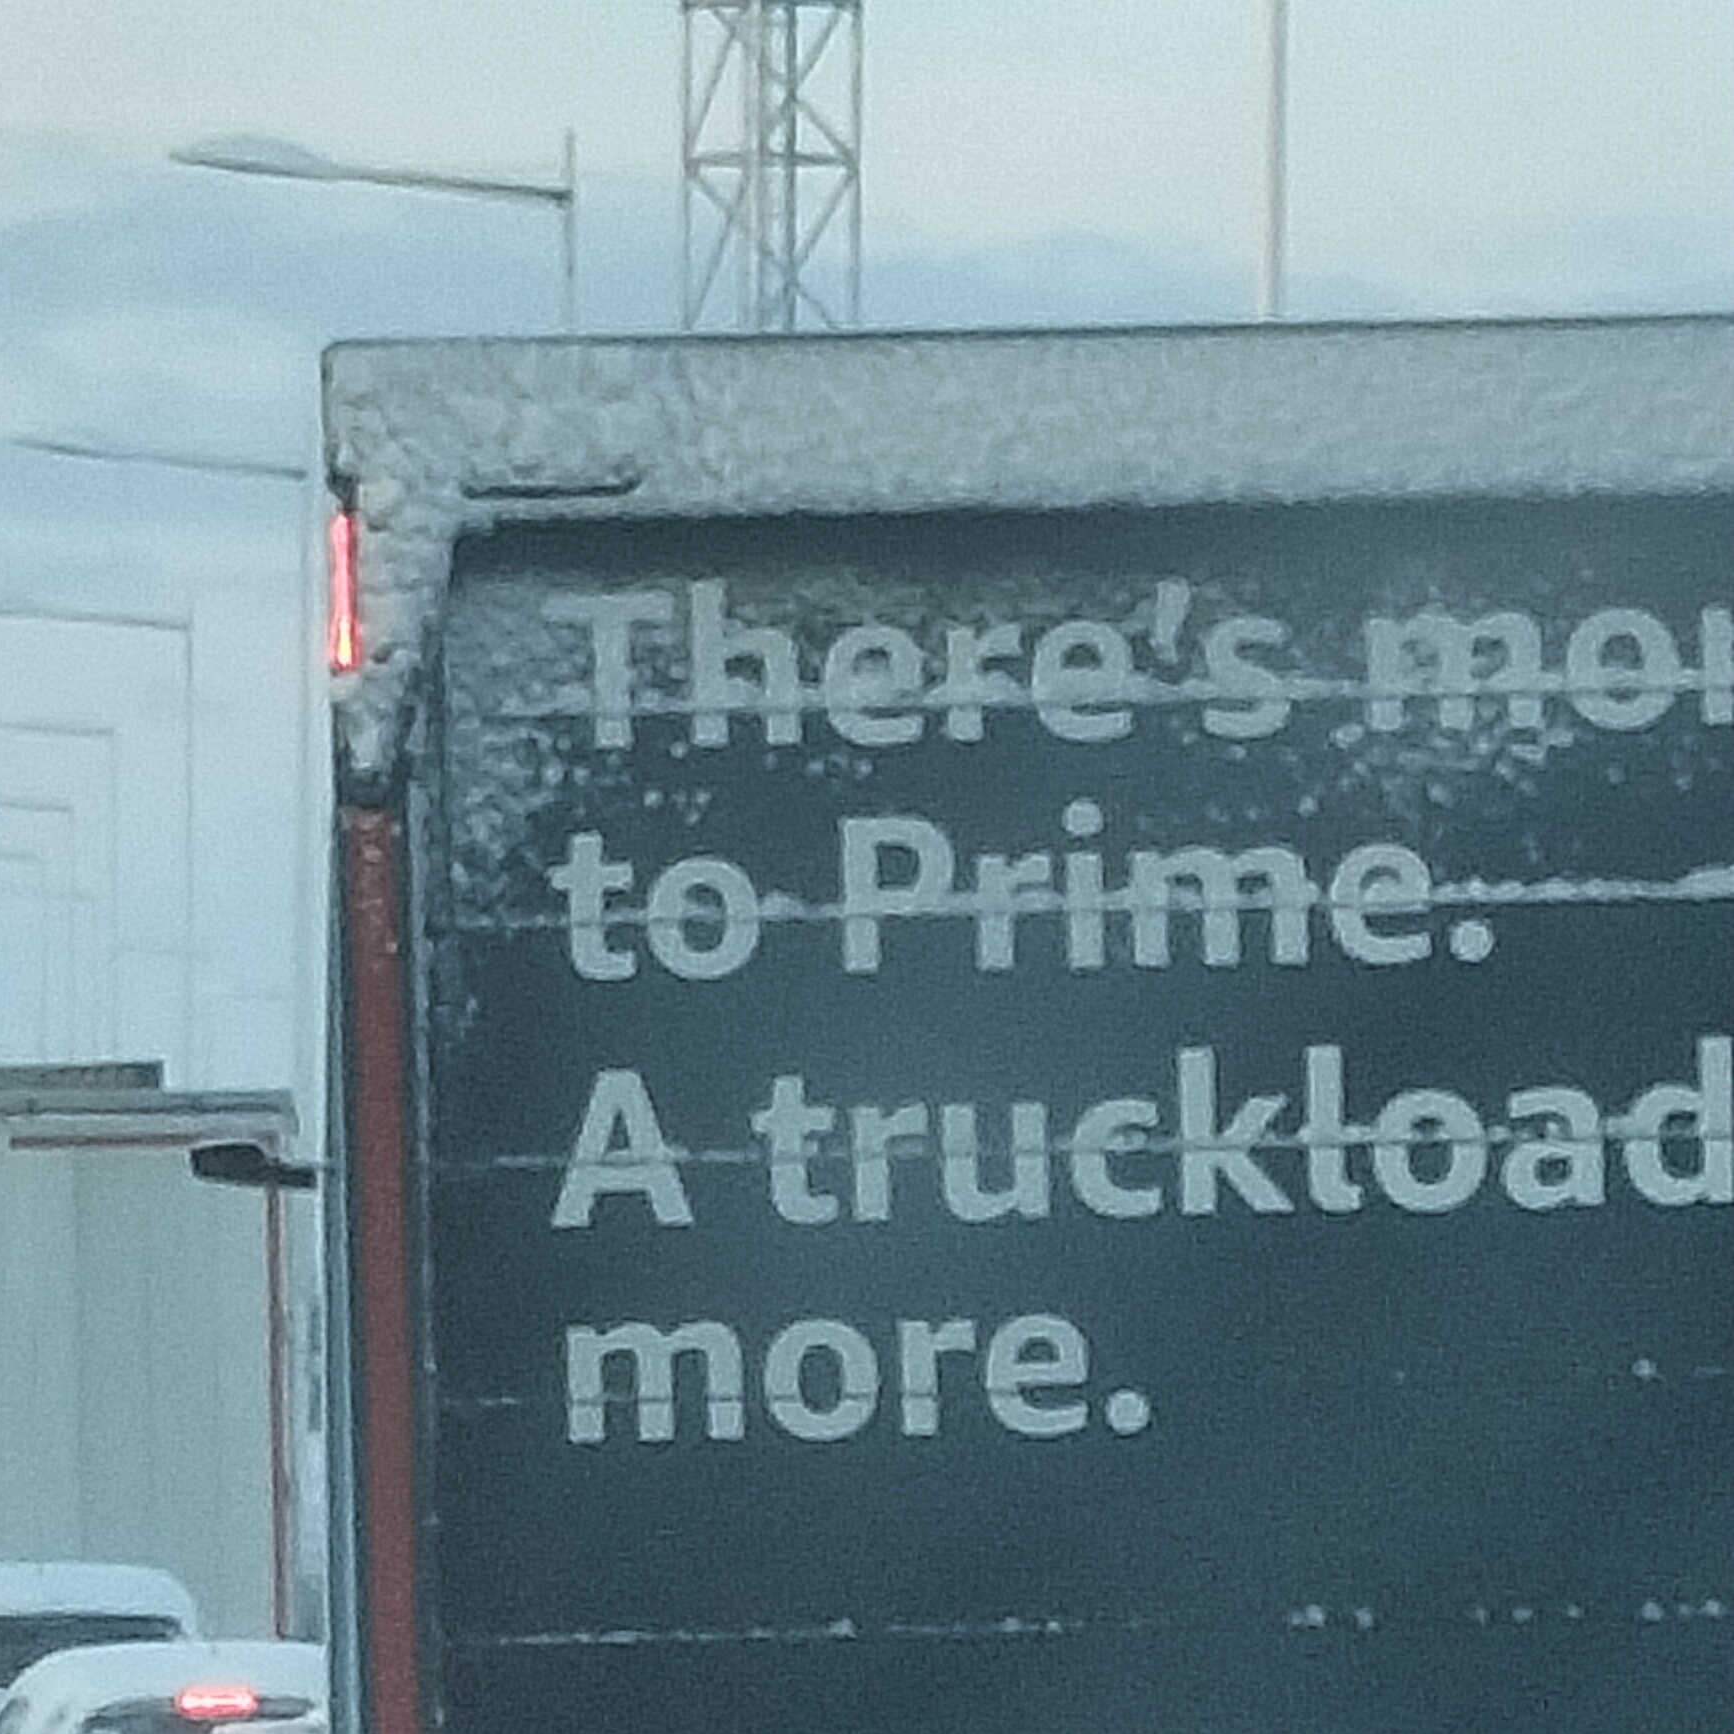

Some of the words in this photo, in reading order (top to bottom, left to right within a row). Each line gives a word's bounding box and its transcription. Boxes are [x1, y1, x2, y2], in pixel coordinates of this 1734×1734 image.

[542, 579, 1292, 750] There's
[547, 829, 762, 981] to
[841, 798, 1496, 974] Prime.
[551, 1067, 694, 1228] A
[751, 1034, 1734, 1224] truckload
[566, 1313, 1151, 1444] more.
